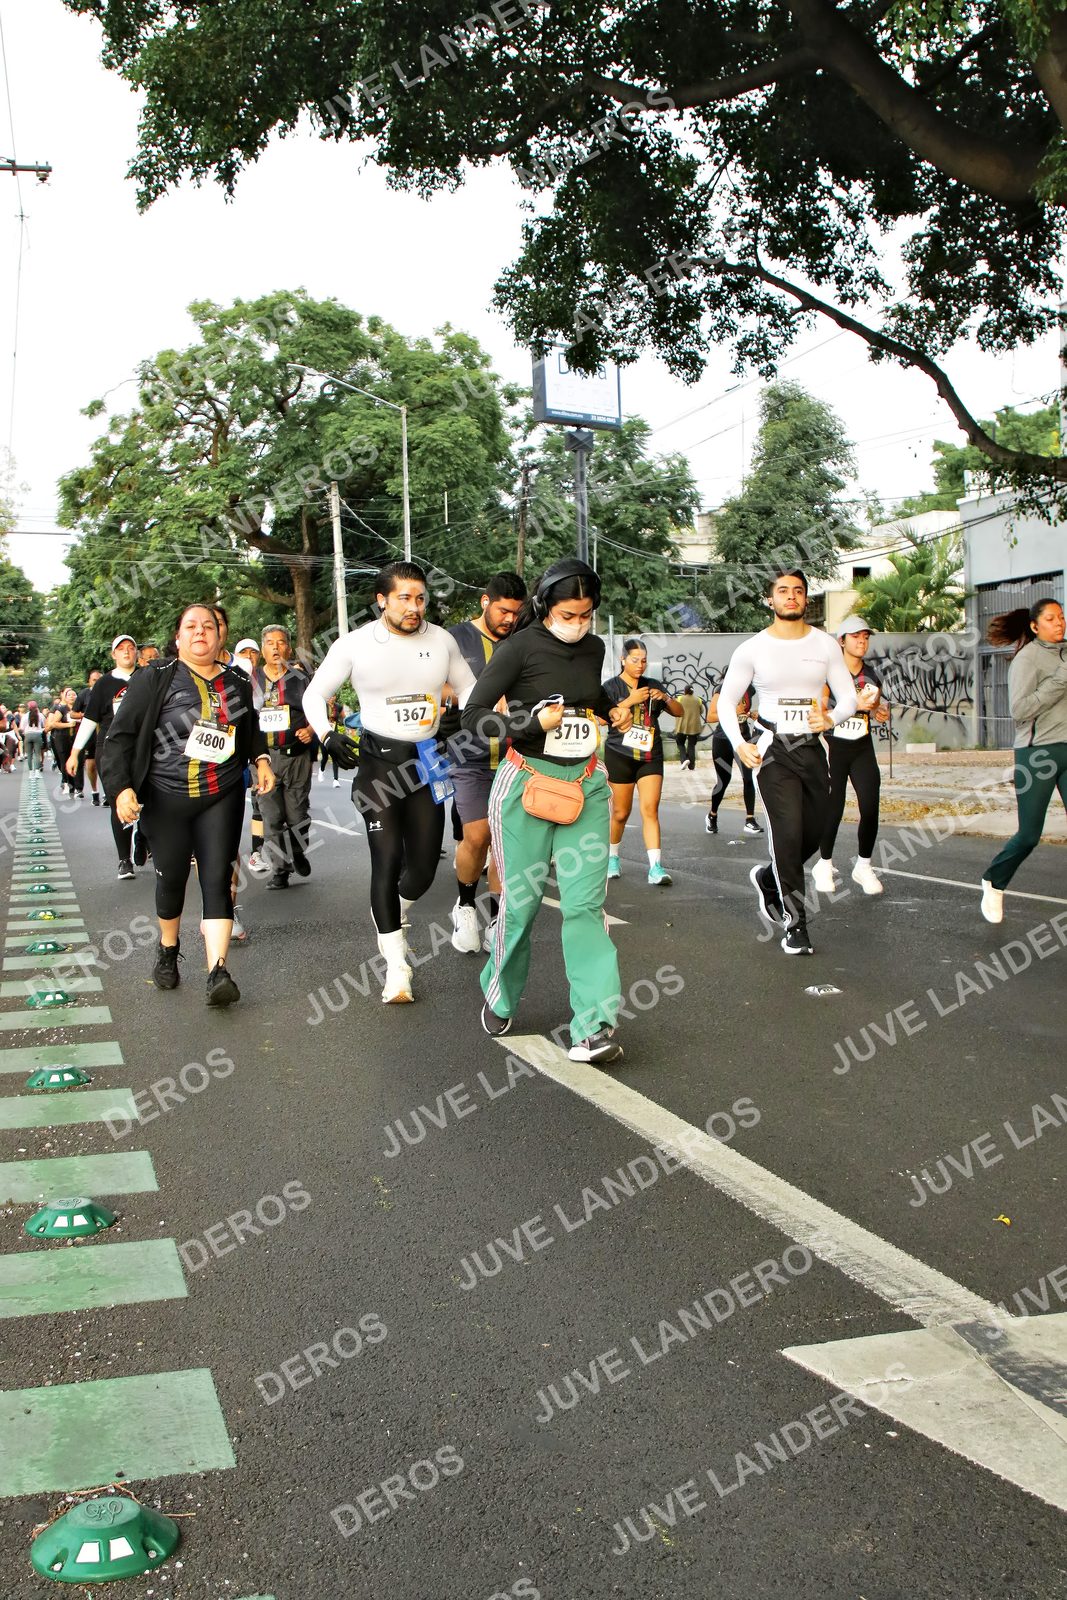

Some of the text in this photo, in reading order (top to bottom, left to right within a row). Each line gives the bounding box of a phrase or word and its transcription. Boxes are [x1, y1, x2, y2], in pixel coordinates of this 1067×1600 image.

[663, 652, 702, 667] TOY
[263, 713, 283, 723] 4975
[394, 706, 427, 723] 1367
[554, 723, 590, 740] 3719
[629, 730, 649, 742] 7345
[195, 731, 225, 751] 4800
